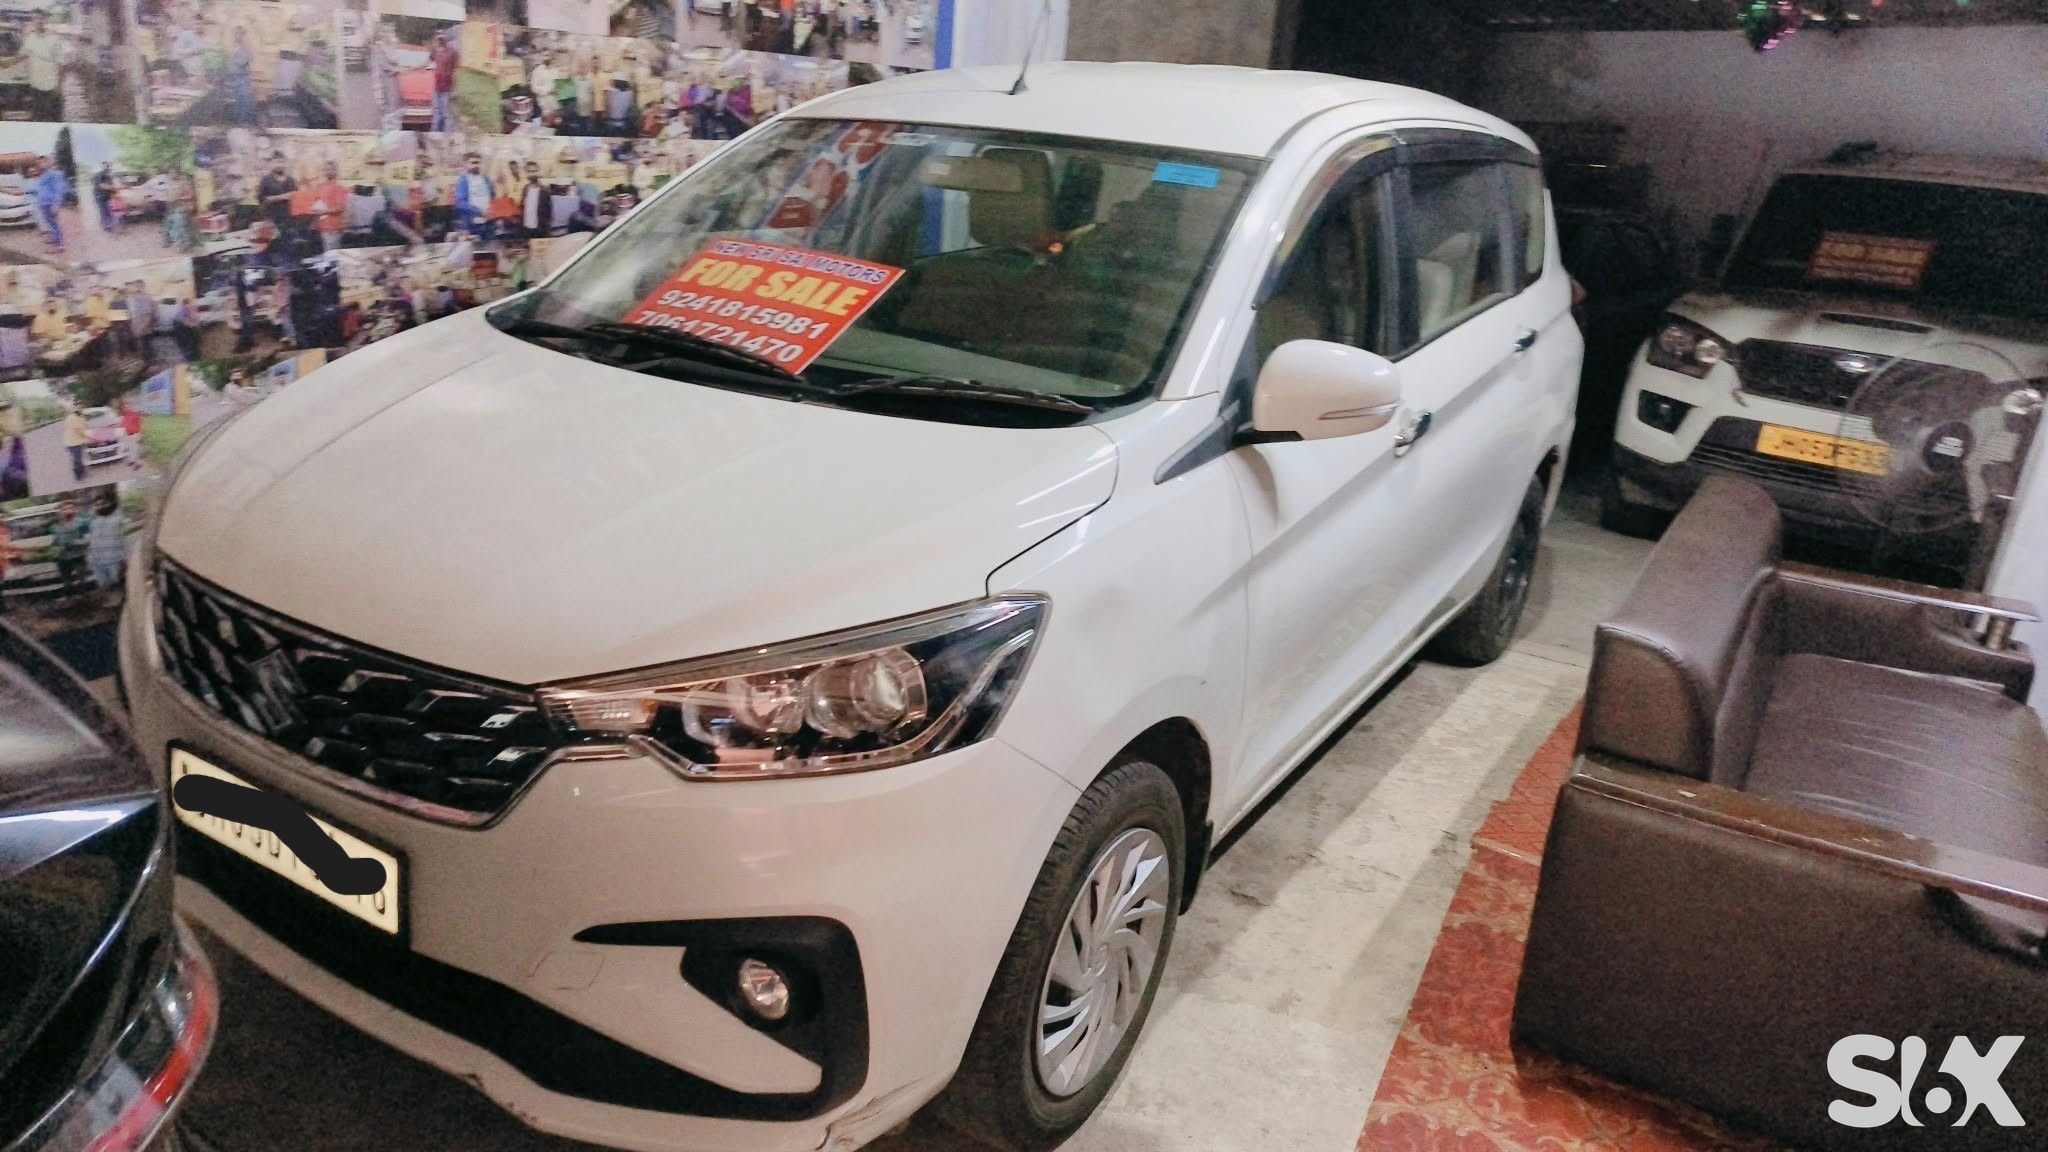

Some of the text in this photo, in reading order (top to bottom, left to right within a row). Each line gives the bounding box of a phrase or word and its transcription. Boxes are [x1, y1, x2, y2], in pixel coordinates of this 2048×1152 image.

[679, 258, 869, 316] FOR SALE
[810, 257, 888, 284] MOTORS
[657, 290, 830, 340] 9241815981
